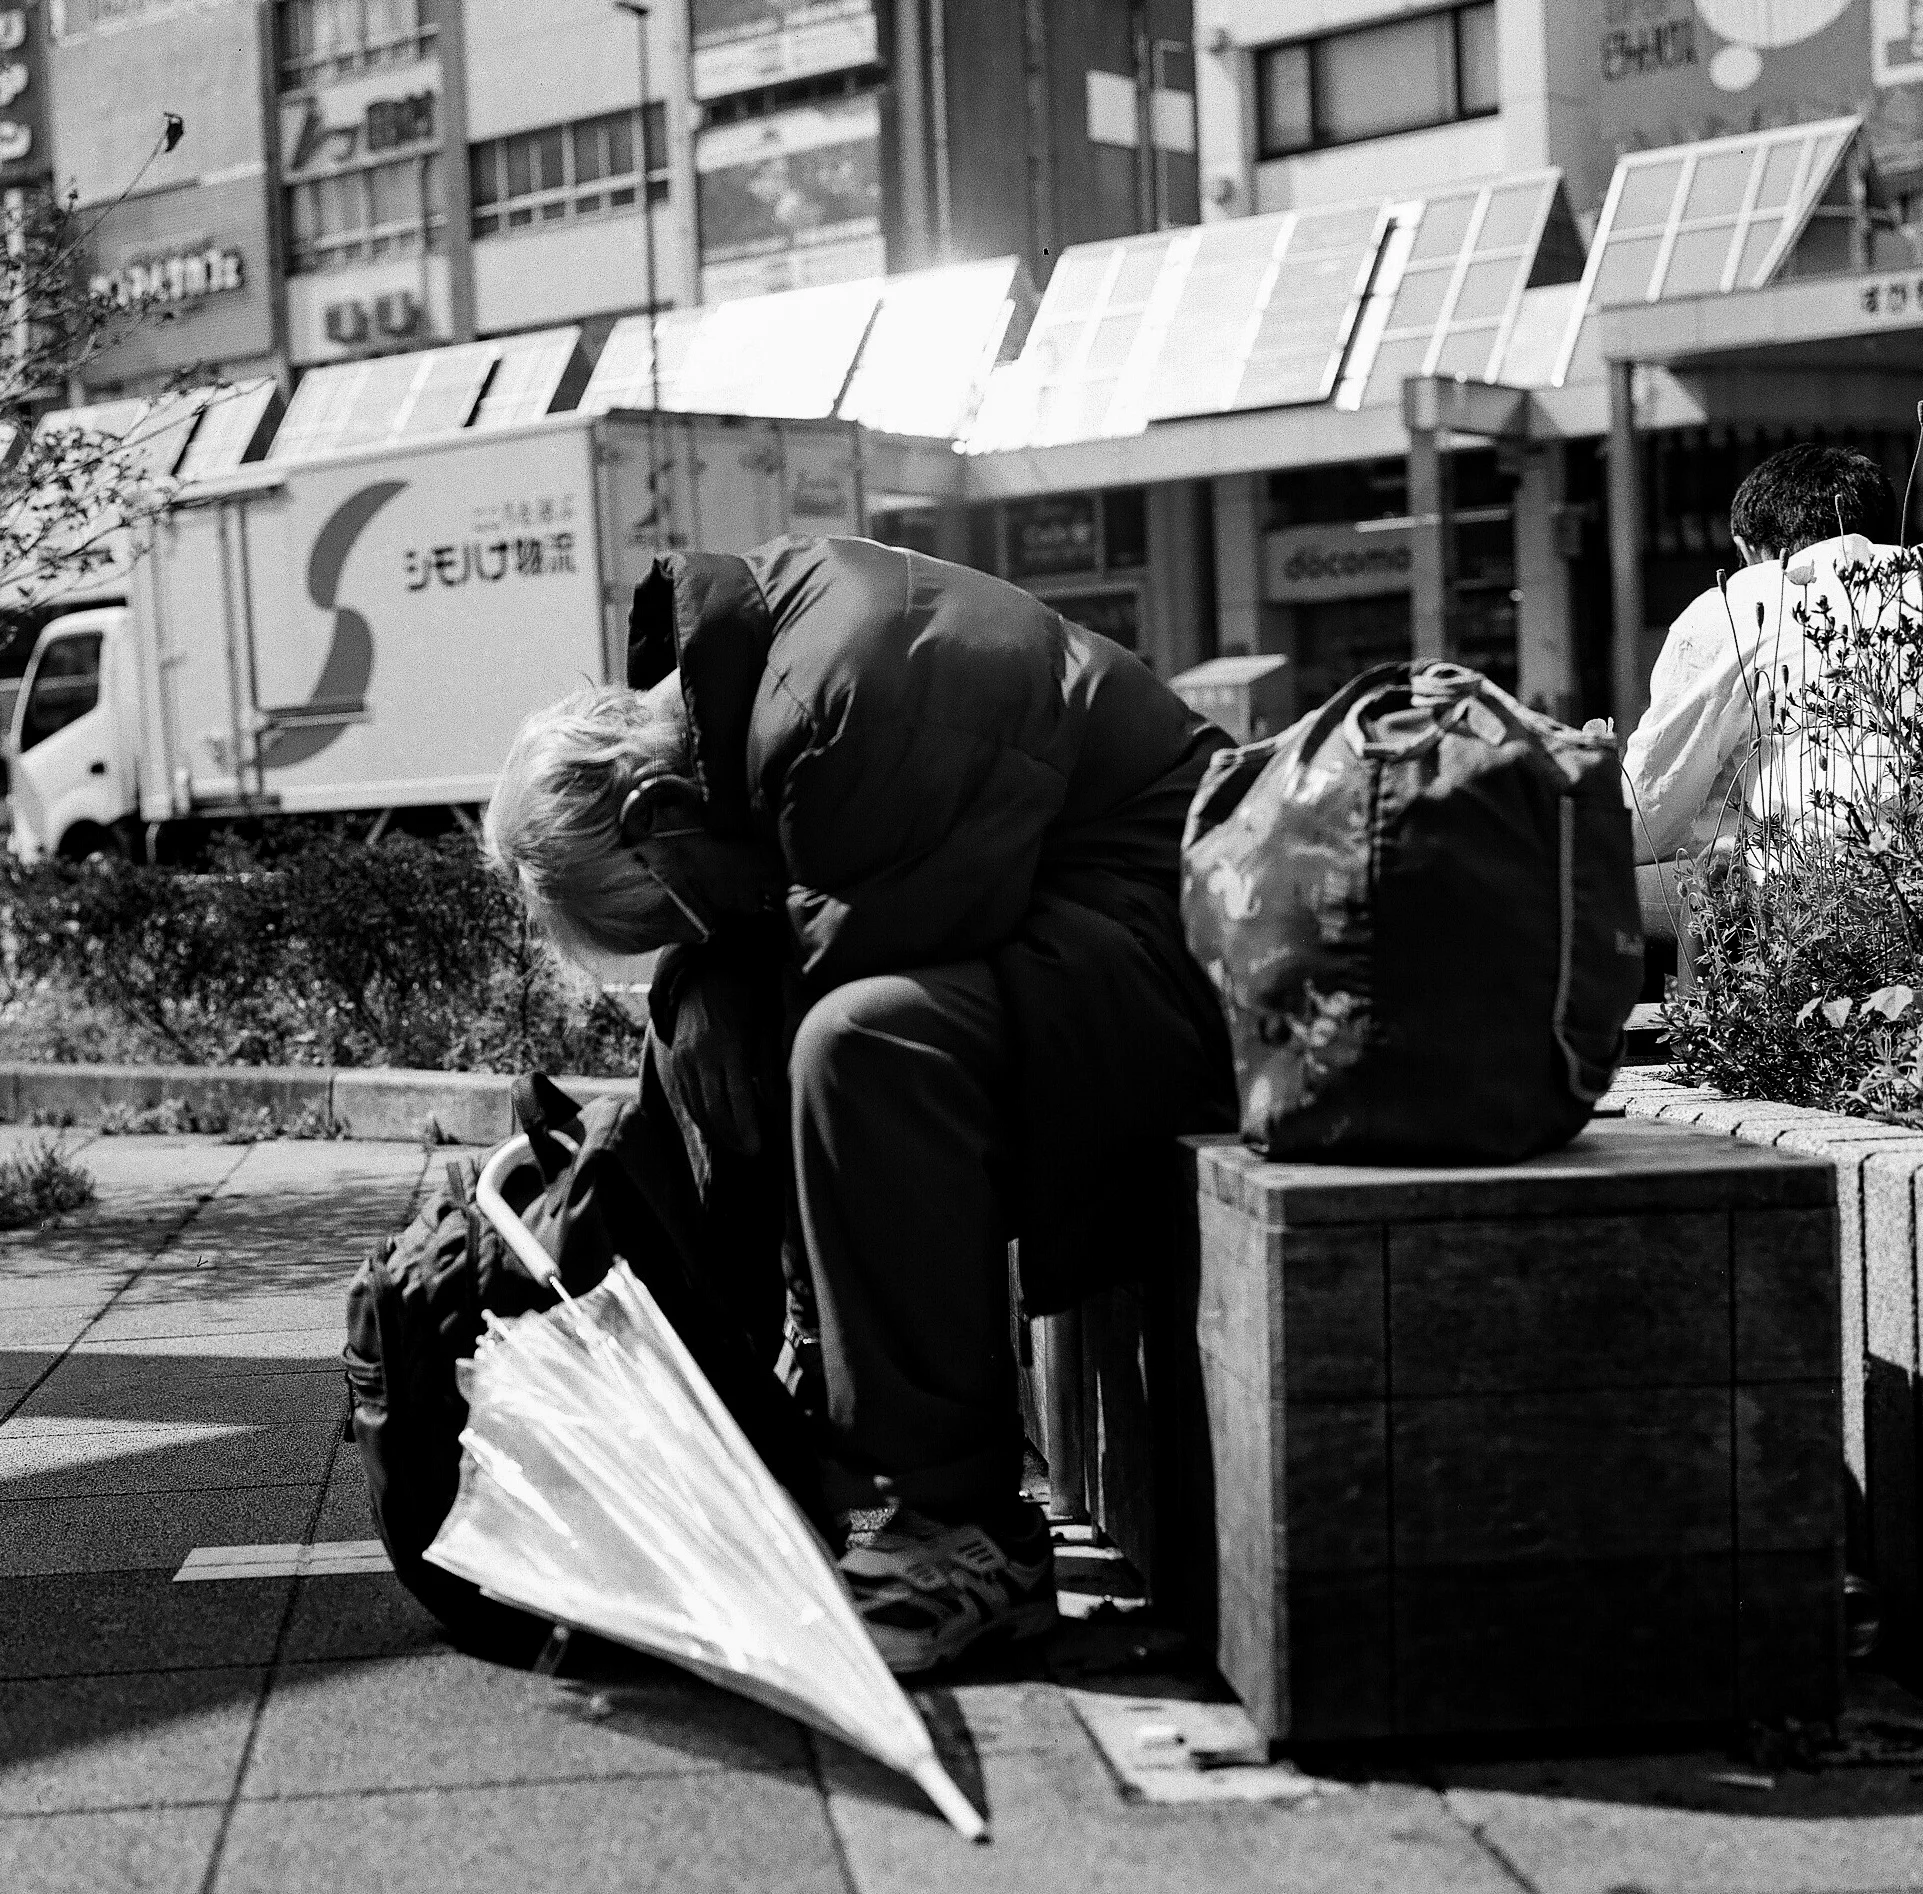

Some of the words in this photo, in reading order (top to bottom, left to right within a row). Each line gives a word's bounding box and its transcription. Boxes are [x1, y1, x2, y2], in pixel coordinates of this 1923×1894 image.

[405, 531, 576, 591] シモハナ物流
